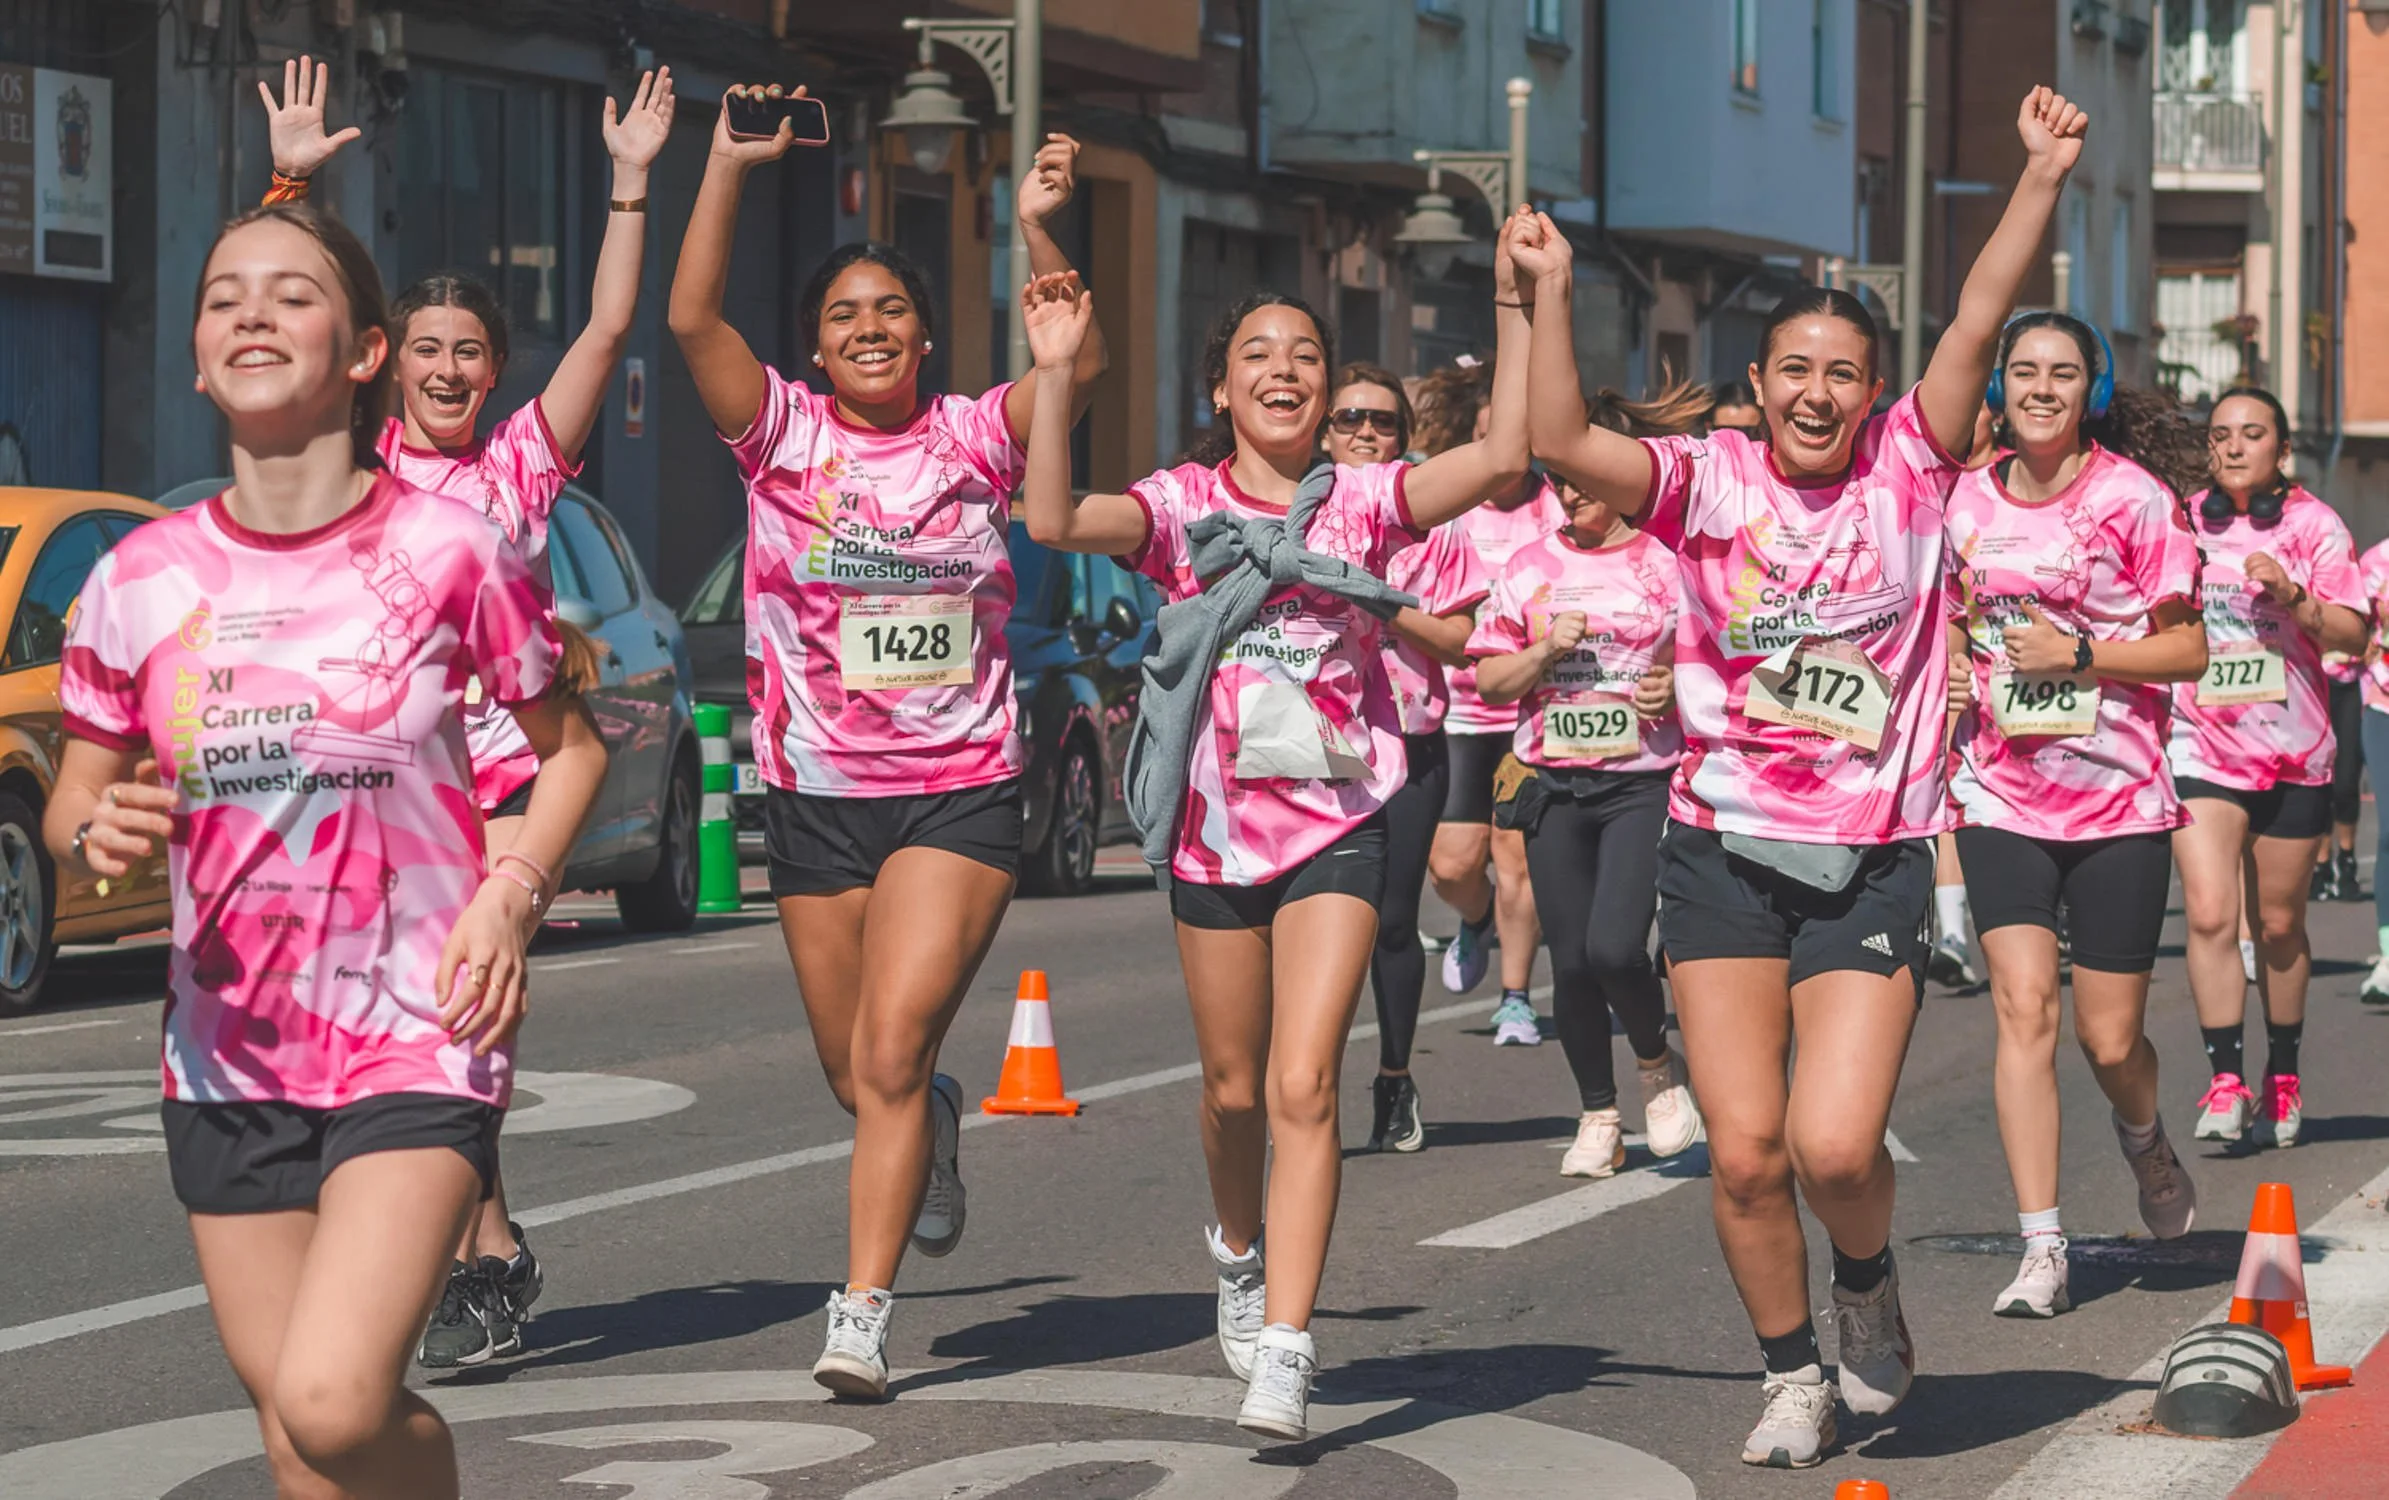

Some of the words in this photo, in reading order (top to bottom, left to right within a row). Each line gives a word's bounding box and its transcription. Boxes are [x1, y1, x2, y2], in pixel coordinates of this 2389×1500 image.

[837, 491, 860, 511] XI
[834, 516, 913, 543] Carrera
[832, 538, 869, 556] por
[830, 557, 973, 584] Investigación
[1766, 561, 1788, 582] XI
[1972, 569, 1987, 587] XI
[1760, 581, 1831, 609] Caera
[1752, 615, 1788, 633] por
[1793, 608, 1815, 628] la
[2010, 609, 2030, 625] la
[863, 623, 952, 663] 1428
[1581, 650, 1598, 663] la
[206, 668, 234, 694] XI
[2211, 659, 2265, 687] 3727
[1777, 659, 1865, 716] 2172
[2003, 680, 2077, 714] 7498
[201, 702, 314, 729] Carrera
[1550, 709, 1628, 739] 10529
[166, 666, 208, 800] mujer
[203, 743, 251, 772] por
[257, 735, 288, 761] la
[210, 765, 396, 799] Investigación
